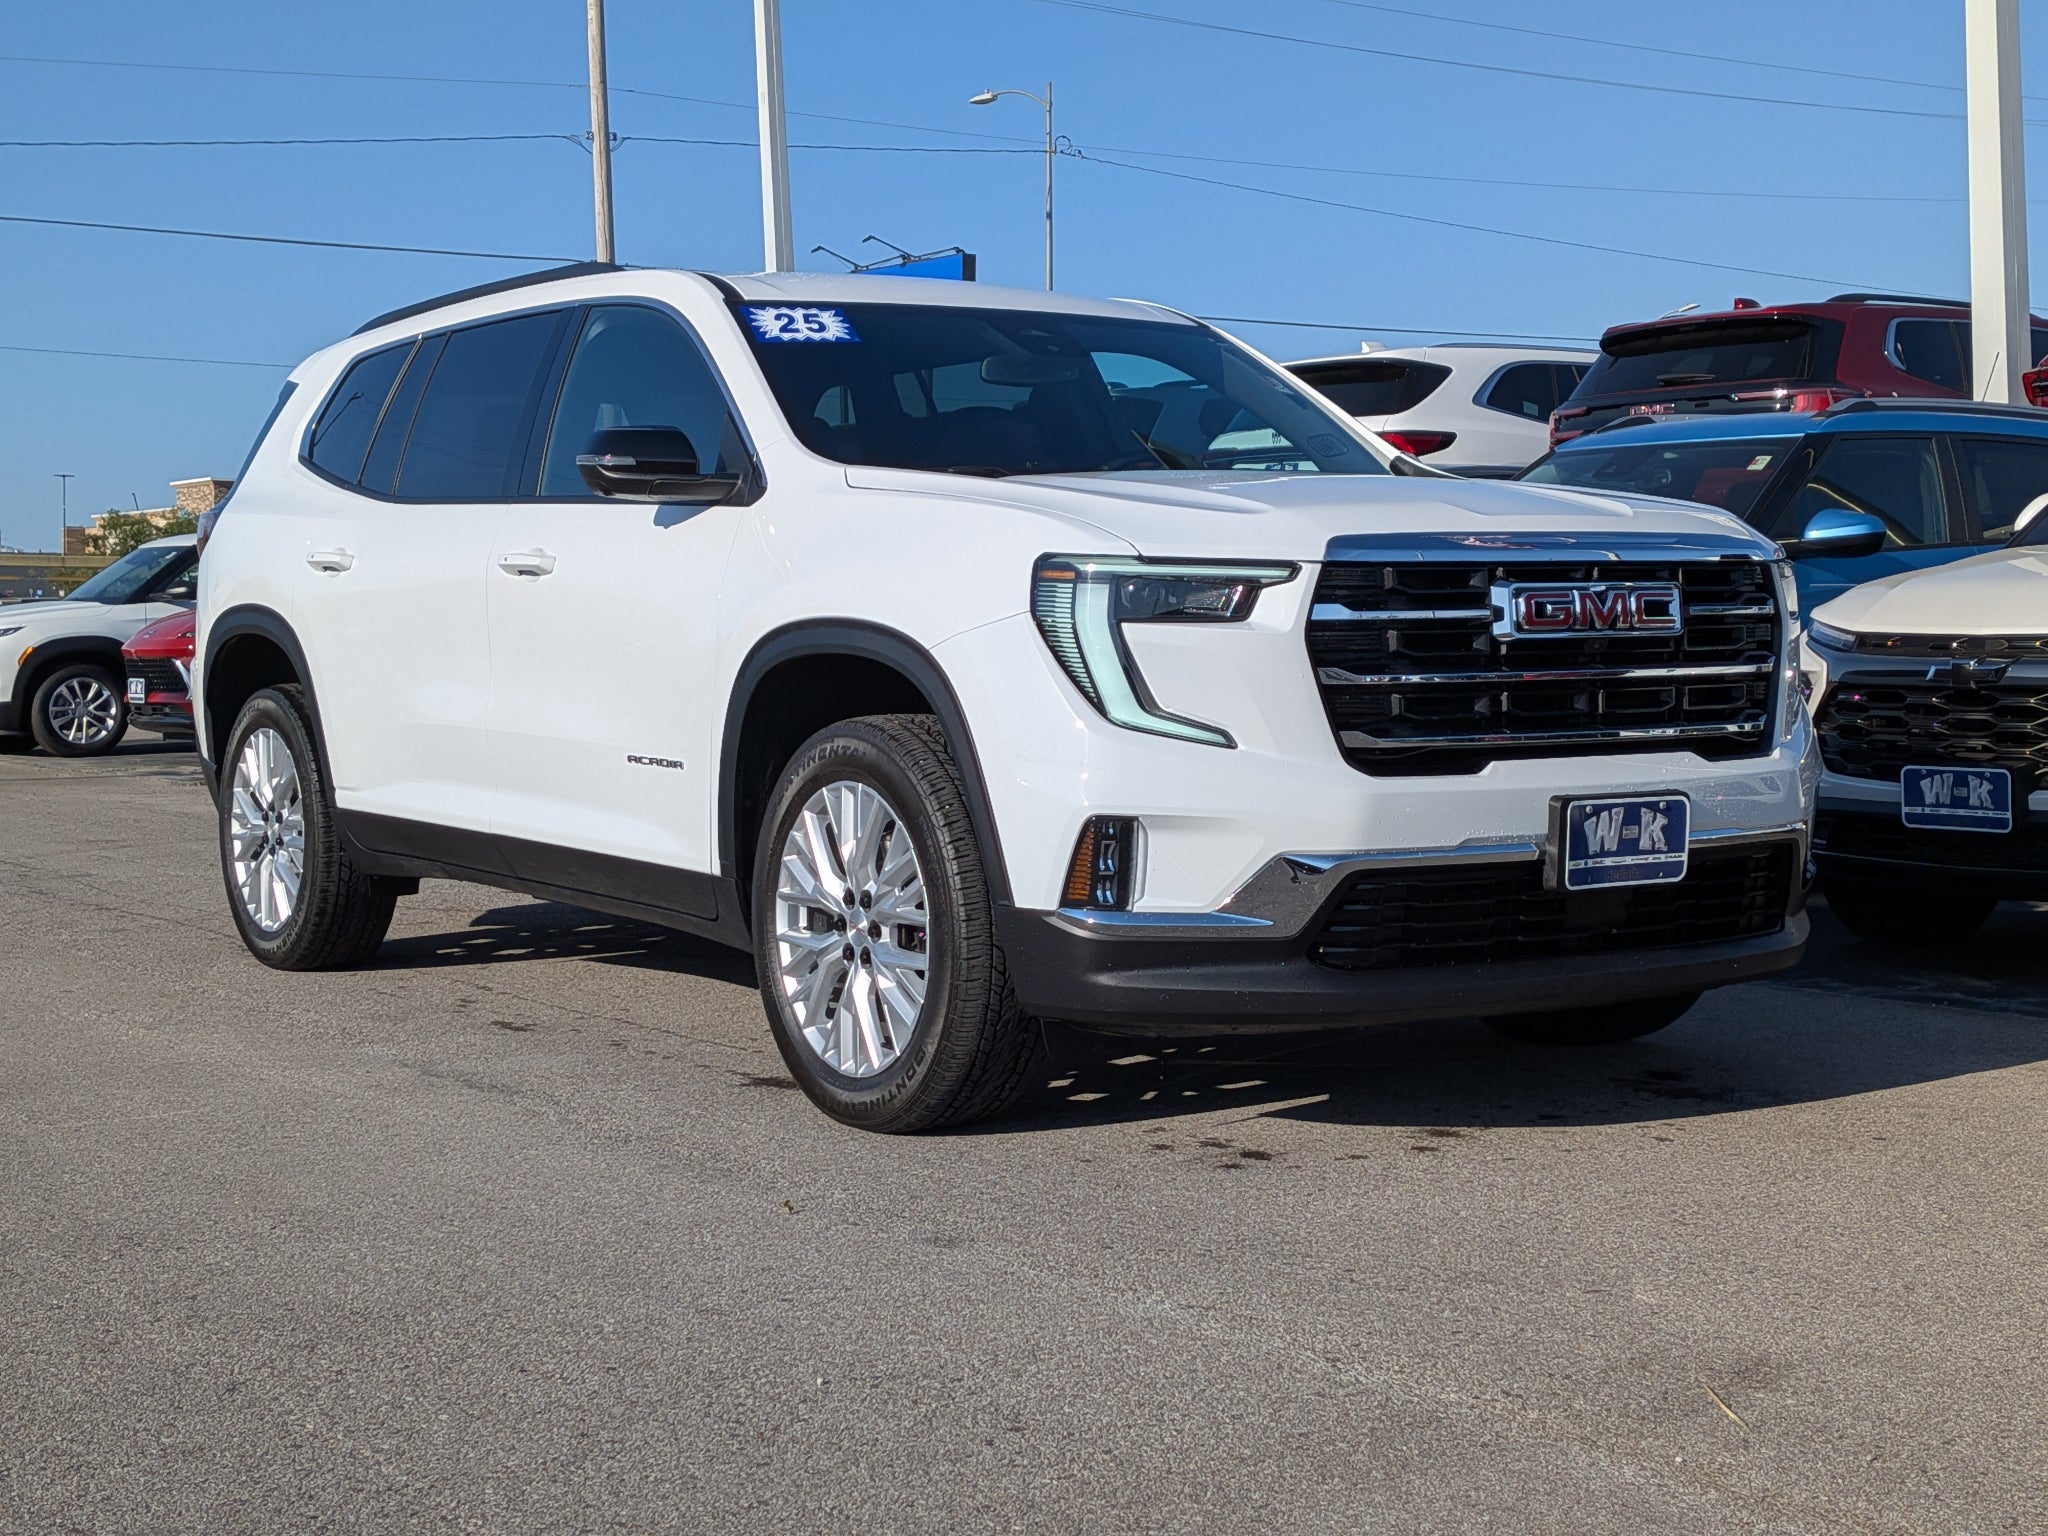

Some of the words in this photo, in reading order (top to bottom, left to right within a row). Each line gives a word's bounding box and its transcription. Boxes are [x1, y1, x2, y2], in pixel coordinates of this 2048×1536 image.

[773, 312, 827, 334] 25
[1630, 403, 1675, 417] GMC
[1519, 590, 1677, 630] GMC
[627, 754, 685, 770] ACADIA
[1919, 773, 1995, 810] W-K
[1583, 806, 1669, 856] W-K
